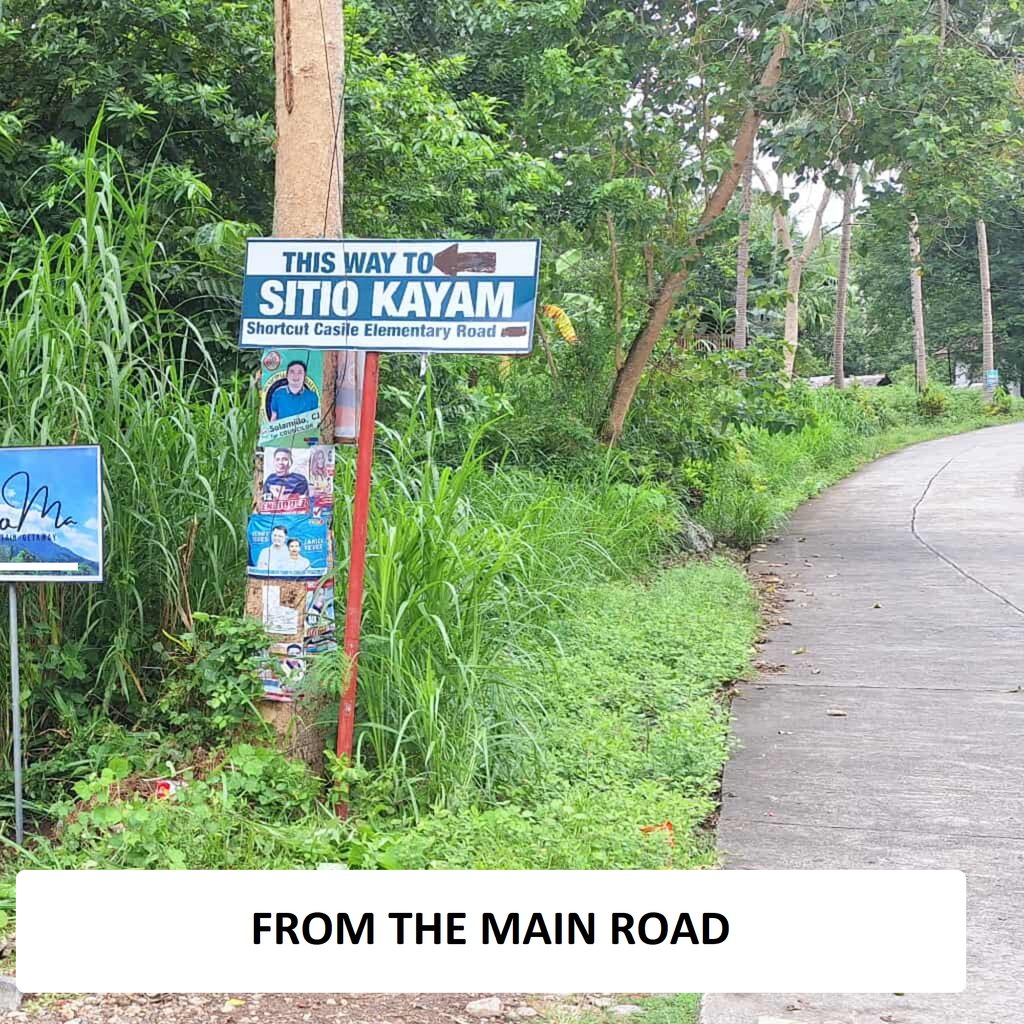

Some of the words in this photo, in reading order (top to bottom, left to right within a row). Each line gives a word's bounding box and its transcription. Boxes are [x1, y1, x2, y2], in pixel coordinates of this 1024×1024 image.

[282, 251, 336, 274] THIS
[344, 251, 396, 274] WAY
[403, 251, 435, 274] TO
[259, 279, 359, 317] SITIO
[371, 280, 515, 318] KAYAM
[247, 321, 309, 337] Shortcut
[314, 321, 359, 337] Casile
[364, 323, 452, 341] Elementary
[456, 324, 497, 338] Road
